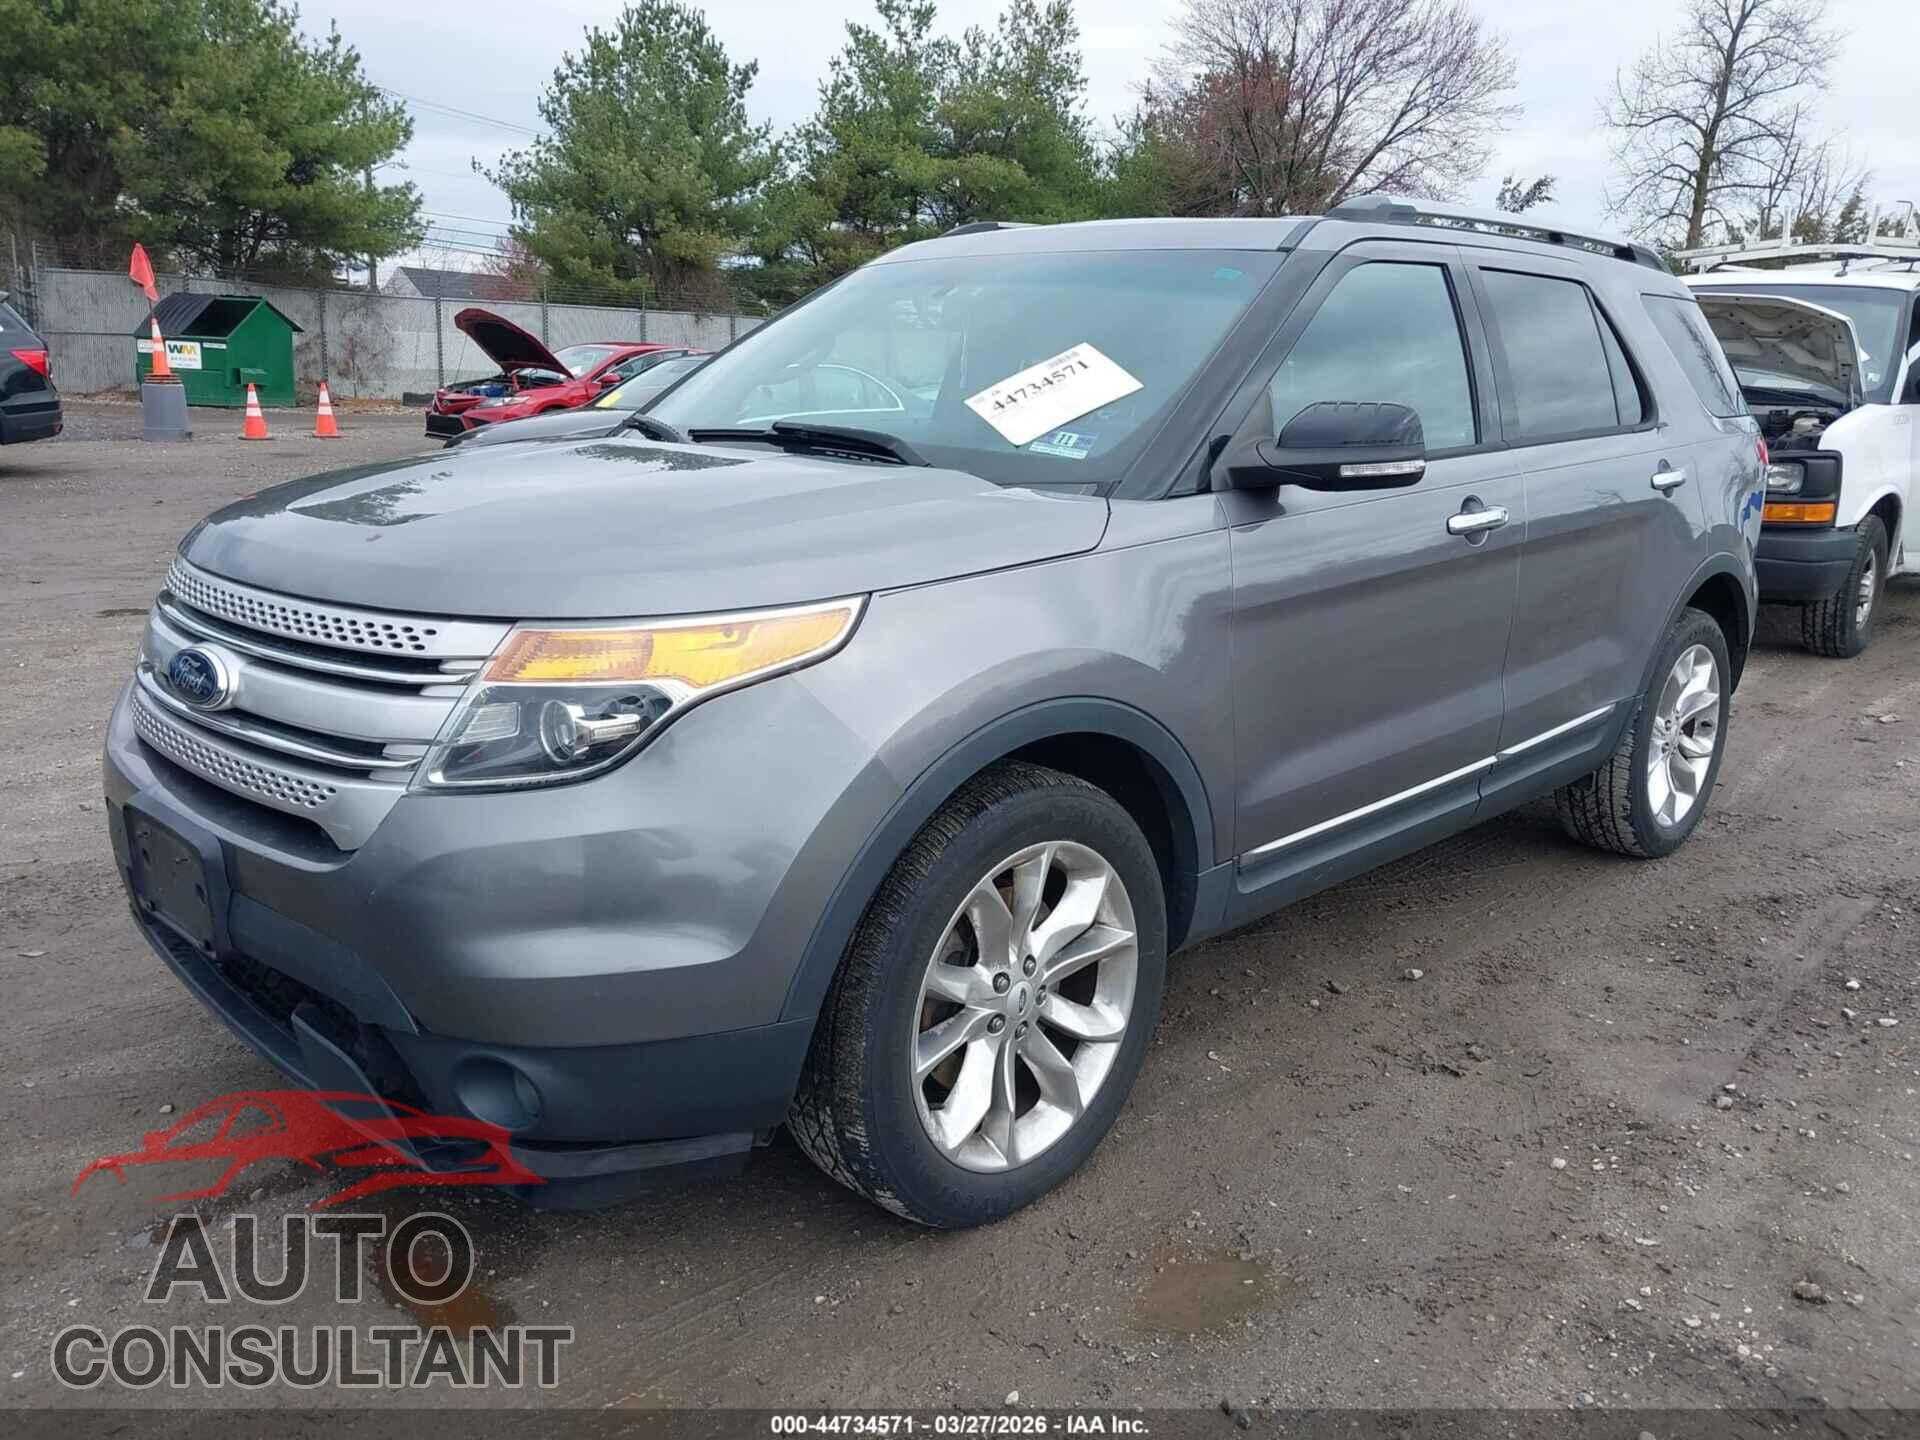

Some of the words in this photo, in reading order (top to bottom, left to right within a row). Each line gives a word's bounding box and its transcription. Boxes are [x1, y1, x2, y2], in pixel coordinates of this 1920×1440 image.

[168, 343, 197, 355] WM
[993, 360, 1089, 411] 44734571
[175, 655, 208, 695] Ford
